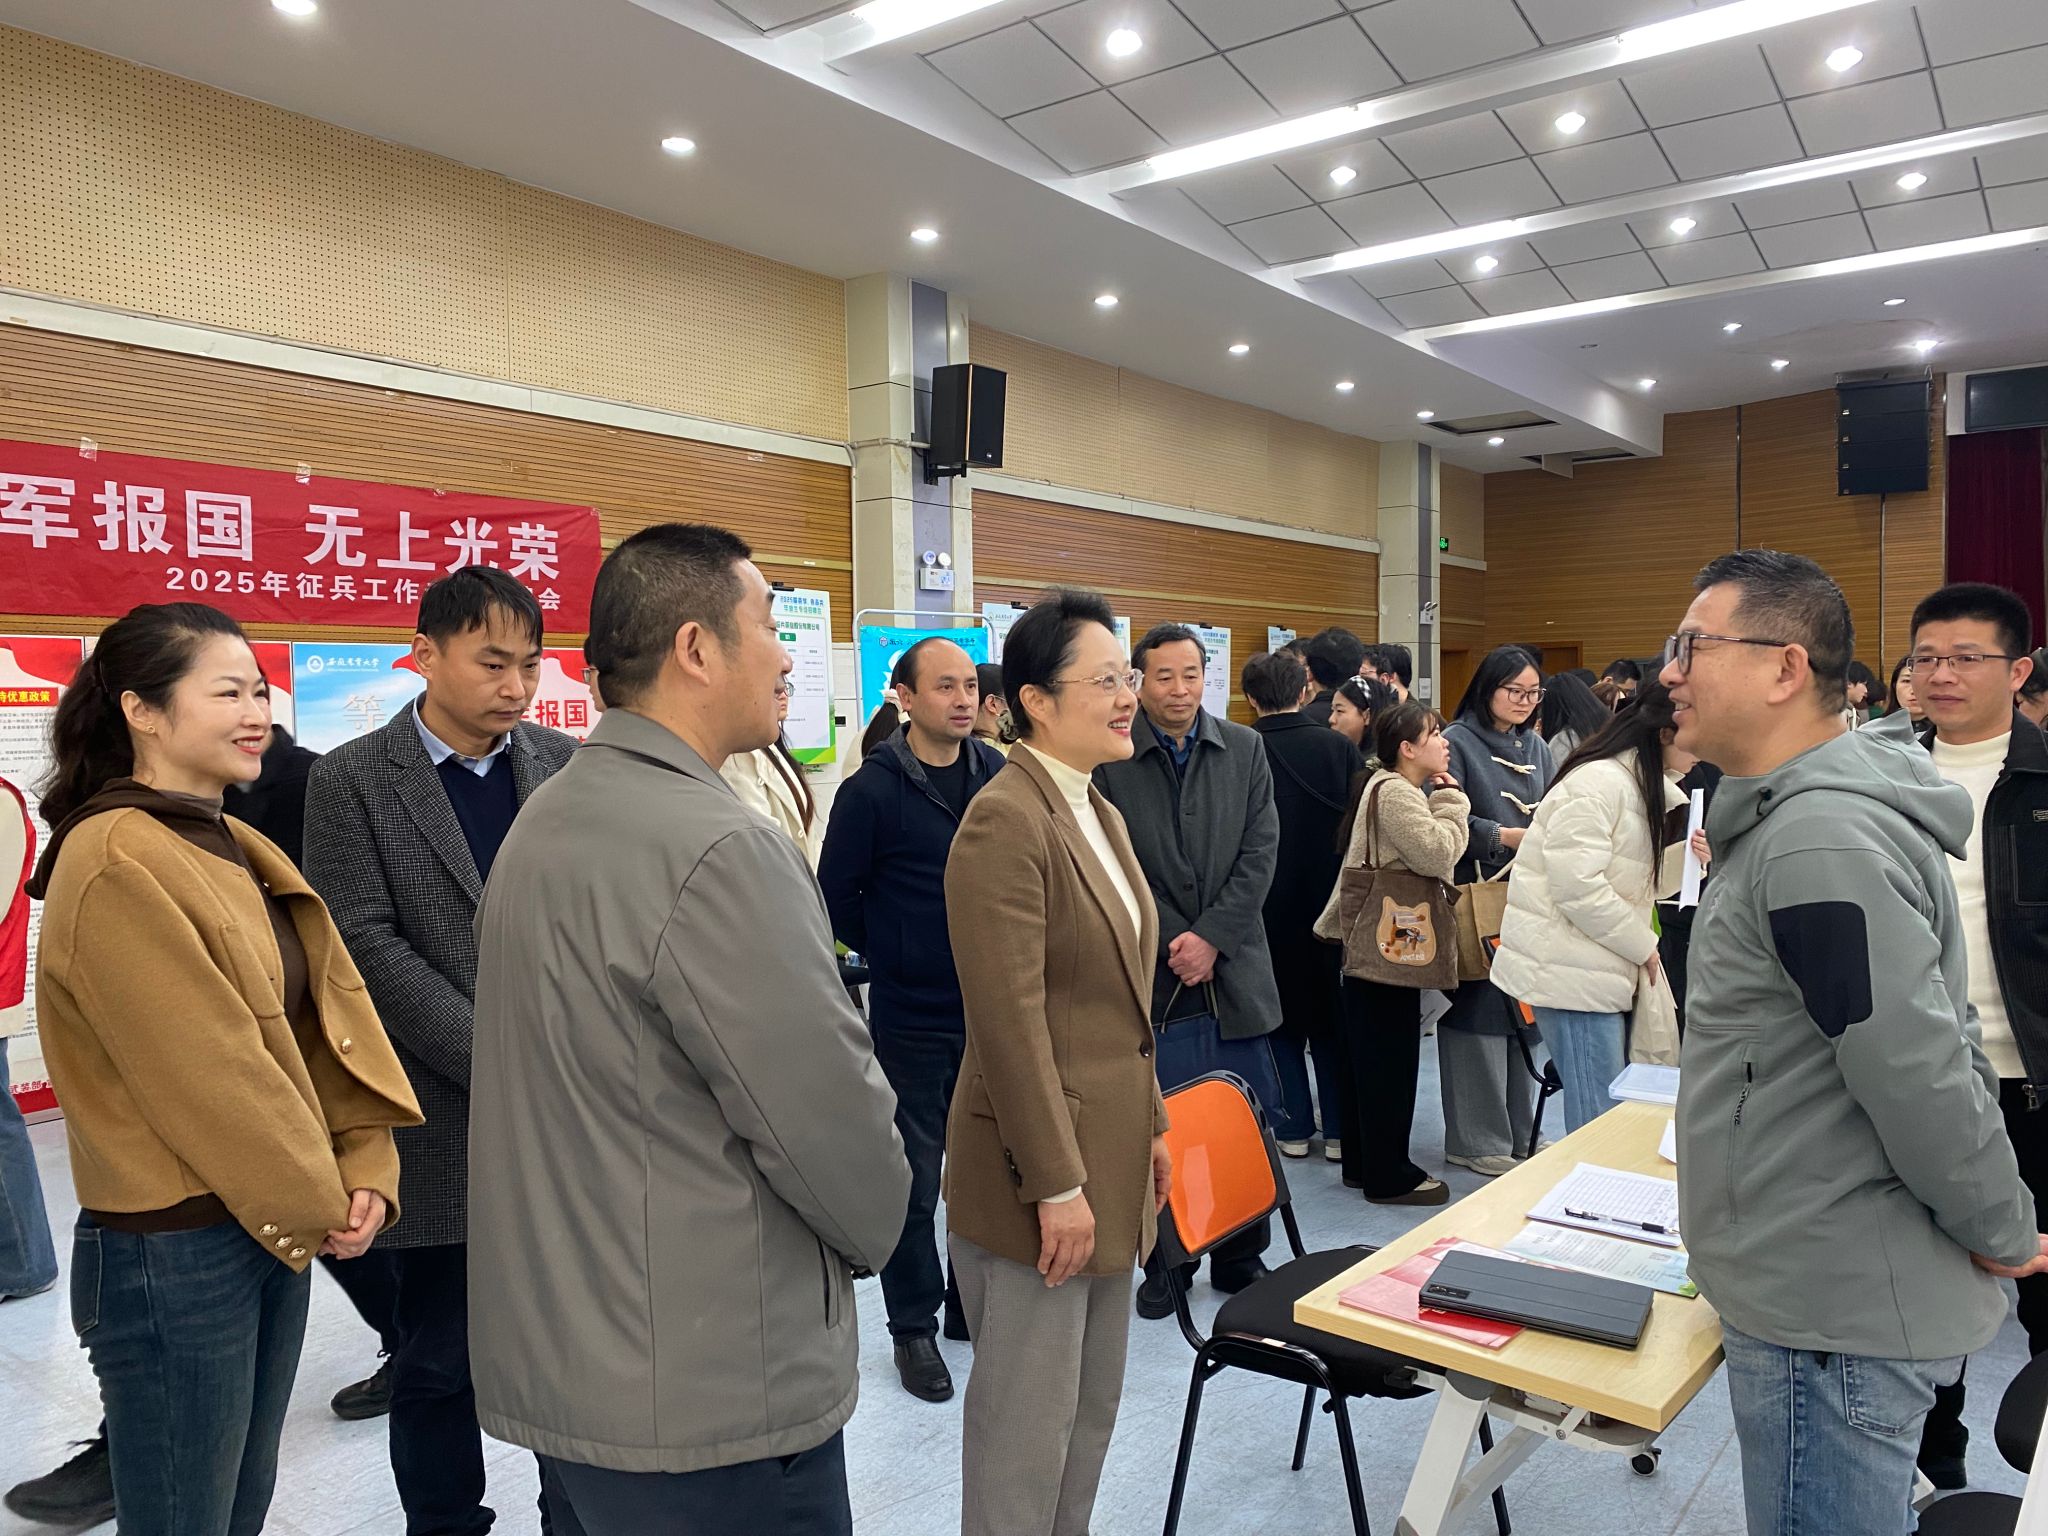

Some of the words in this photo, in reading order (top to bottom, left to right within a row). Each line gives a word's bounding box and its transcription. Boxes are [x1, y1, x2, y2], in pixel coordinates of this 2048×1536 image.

[0, 472, 253, 562] 军报国
[303, 504, 561, 581] 无上光荣
[165, 567, 561, 611] 2025年征兵工作会
[520, 699, 588, 729] 报国
